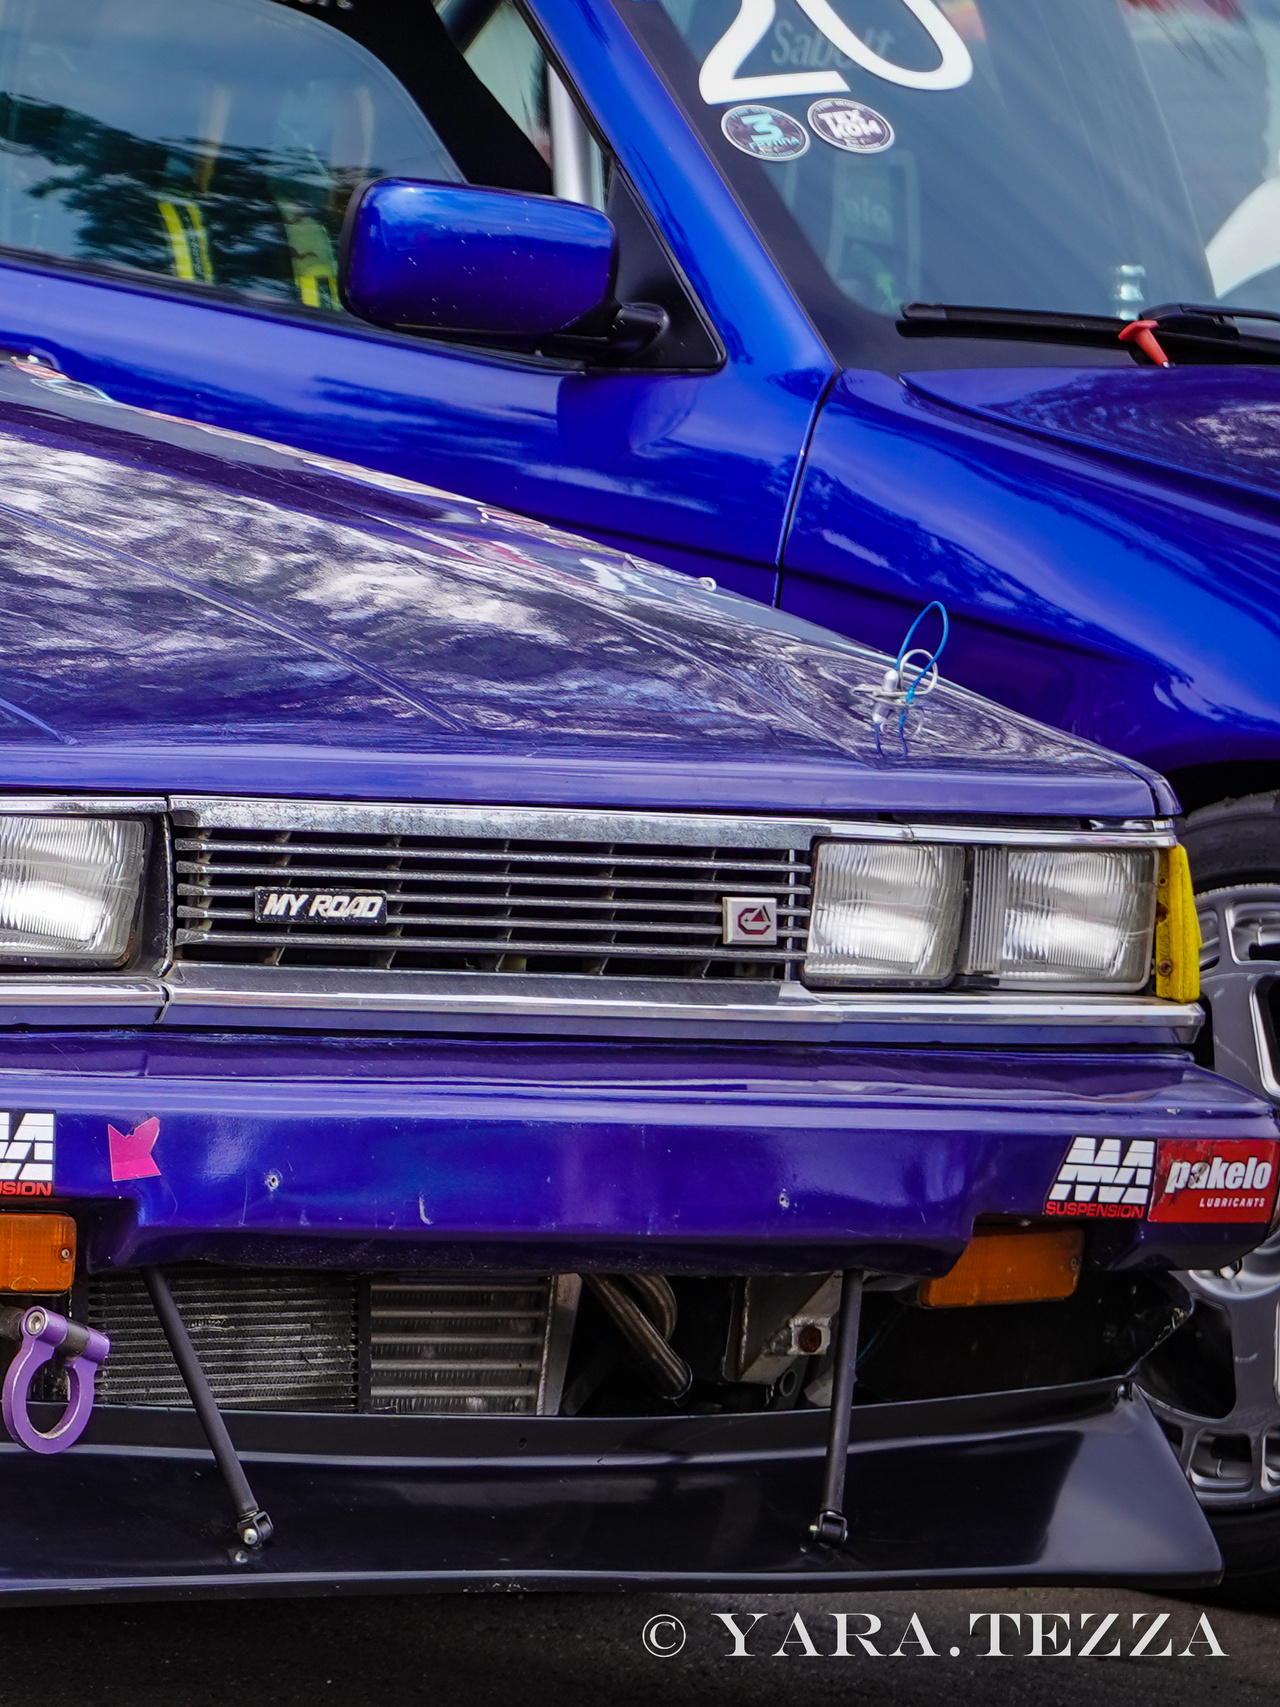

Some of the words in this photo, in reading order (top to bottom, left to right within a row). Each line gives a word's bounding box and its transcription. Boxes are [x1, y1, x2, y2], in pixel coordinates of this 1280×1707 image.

[263, 894, 309, 916] MY
[308, 895, 383, 918] ROAD
[1165, 1157, 1272, 1193] pakelo
[1045, 1202, 1145, 1218] SUSPENSION
[1200, 1197, 1265, 1208] LUBRICANTS
